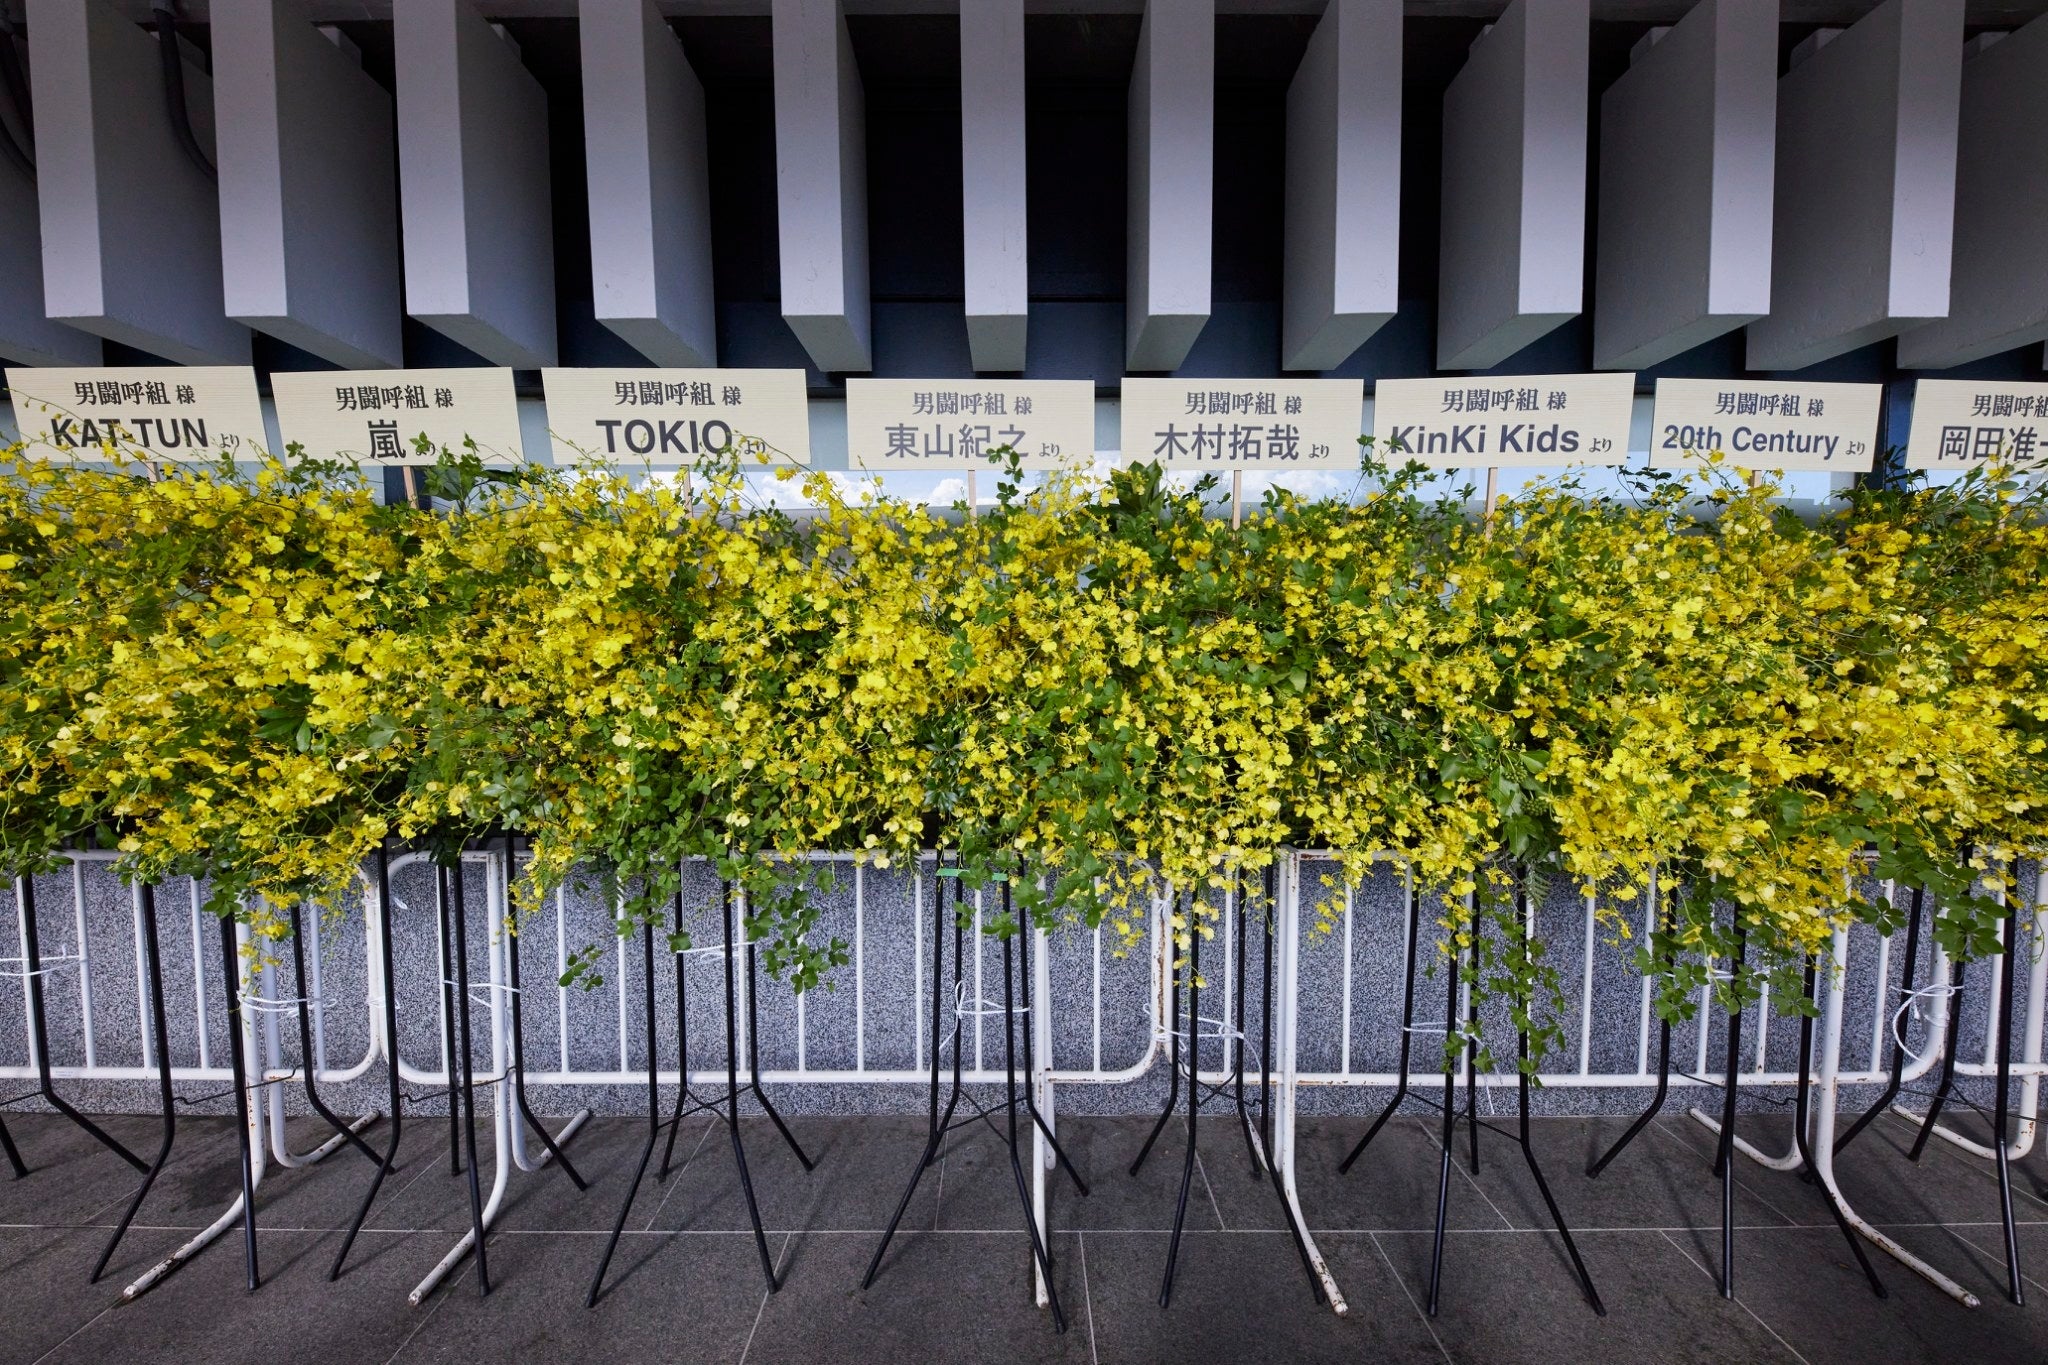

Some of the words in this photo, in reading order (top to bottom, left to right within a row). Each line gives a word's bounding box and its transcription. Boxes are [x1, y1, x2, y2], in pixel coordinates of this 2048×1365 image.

[74, 381, 171, 406] 男闘呼組
[176, 384, 196, 405] 様
[336, 385, 429, 411] 男闘呼組
[434, 388, 454, 408] 様
[614, 381, 715, 406] 男闘呼組
[722, 385, 742, 406] 様
[913, 392, 1007, 415] 男闘呼組
[1013, 396, 1032, 415] 様
[1184, 392, 1277, 415] 男闘呼組
[1284, 396, 1302, 415] 様
[1441, 388, 1540, 413] 男闘呼組
[1546, 391, 1567, 411] 様
[1714, 392, 1801, 417] 男闘呼組
[1807, 398, 1825, 417] 様
[219, 433, 240, 449] より
[367, 419, 406, 460] 嵐
[595, 419, 733, 455] TOKIO
[884, 423, 1030, 459] 東山紀之
[1038, 442, 1060, 458] より
[1153, 422, 1300, 461] 木村拓哉
[1307, 442, 1331, 460] より
[1390, 424, 1486, 455] KinKi
[1499, 423, 1580, 453] Kids
[1588, 438, 1613, 454] より
[1662, 424, 1722, 450] 20th
[1732, 425, 1840, 461] Century
[1844, 440, 1867, 457] より
